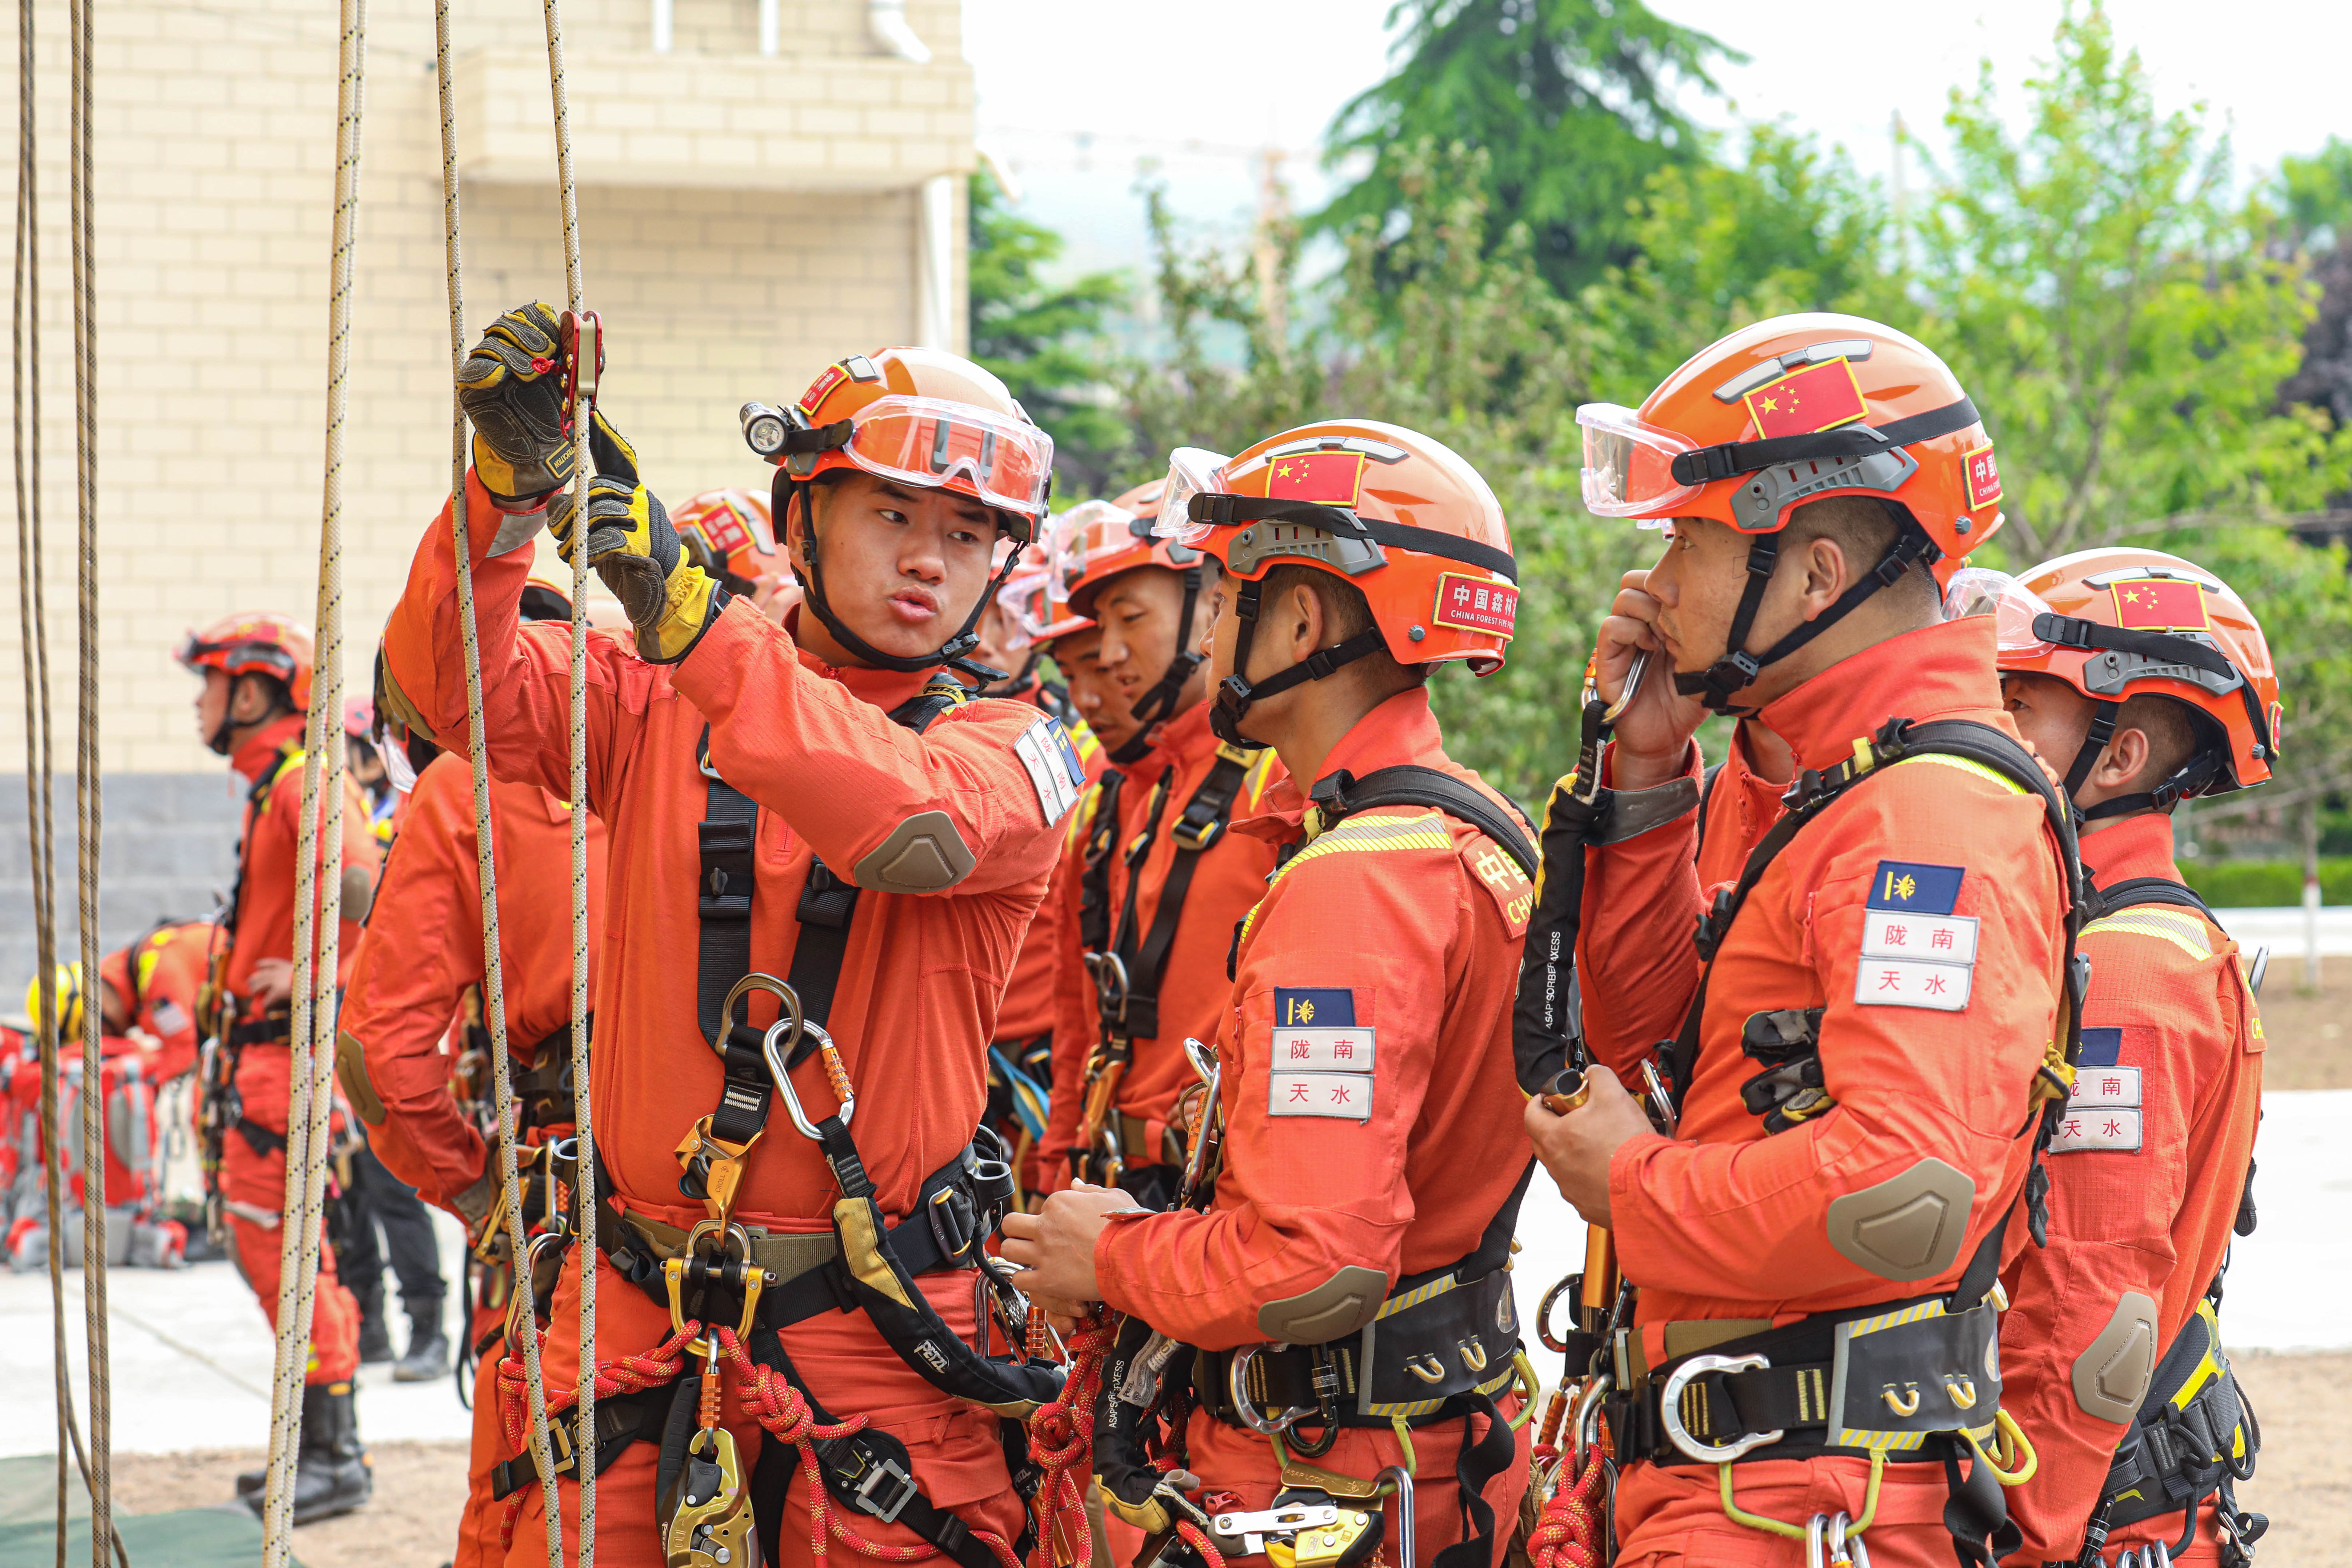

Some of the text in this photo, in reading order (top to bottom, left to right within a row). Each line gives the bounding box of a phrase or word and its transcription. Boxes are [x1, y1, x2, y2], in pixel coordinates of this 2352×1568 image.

[554, 447, 575, 469] TRICATION
[1975, 453, 1997, 483] 中国
[1979, 484, 1993, 496] CHINA
[1451, 610, 1475, 621] CHINA
[1476, 614, 1498, 625] FOREST
[1499, 619, 1507, 628] FIRE
[1041, 737, 1067, 786] 陇南
[1027, 752, 1052, 805] 天水
[1507, 892, 1533, 924] CHI
[1885, 925, 1955, 949] 陇南
[1878, 971, 1947, 995] 天水
[1291, 1039, 1354, 1059] 陇南
[1289, 1083, 1351, 1104] 天水
[2064, 1119, 2121, 1139] 天水
[715, 1175, 726, 1192] CROLL
[914, 1340, 947, 1374] PETZL
[1285, 1469, 1325, 1484] ASAP LOOK
